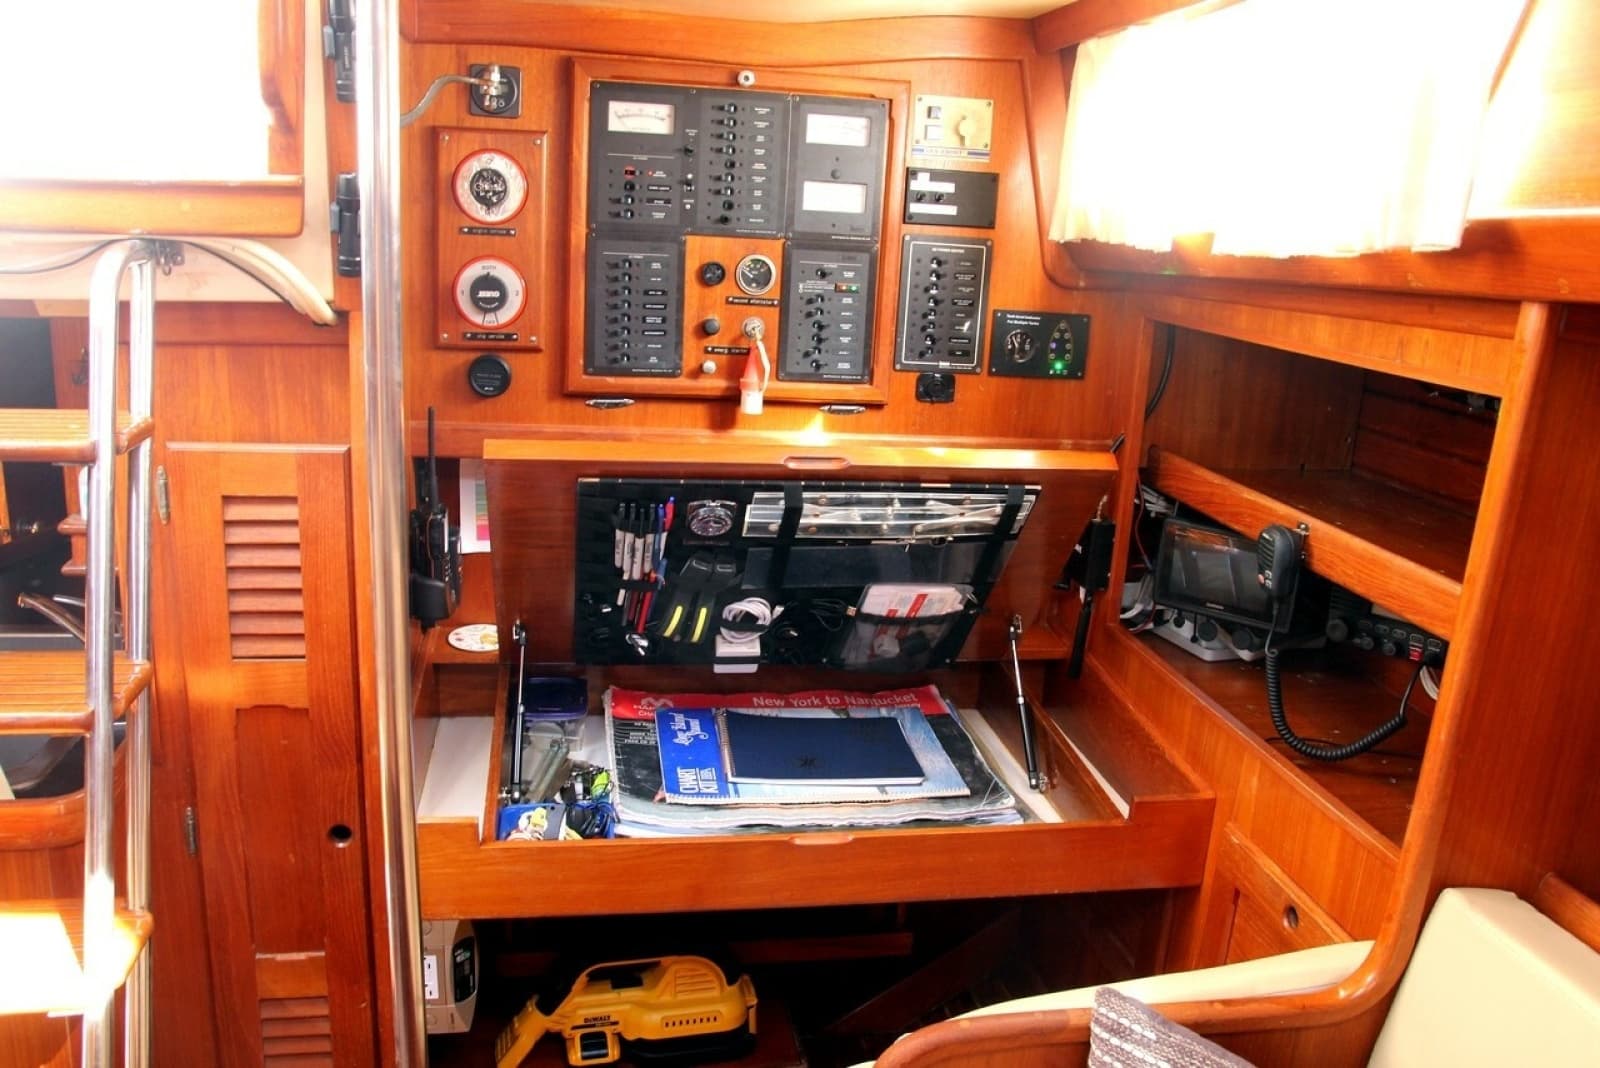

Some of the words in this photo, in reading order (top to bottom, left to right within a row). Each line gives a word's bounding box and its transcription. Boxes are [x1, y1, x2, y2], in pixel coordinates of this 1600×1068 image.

[752, 696, 785, 707] New
[789, 696, 821, 707] York
[825, 695, 841, 706] to
[846, 692, 919, 706] Nantucket
[677, 766, 699, 794] CHART
[699, 779, 719, 794] KIT
[583, 1015, 611, 1024] DEWALT
